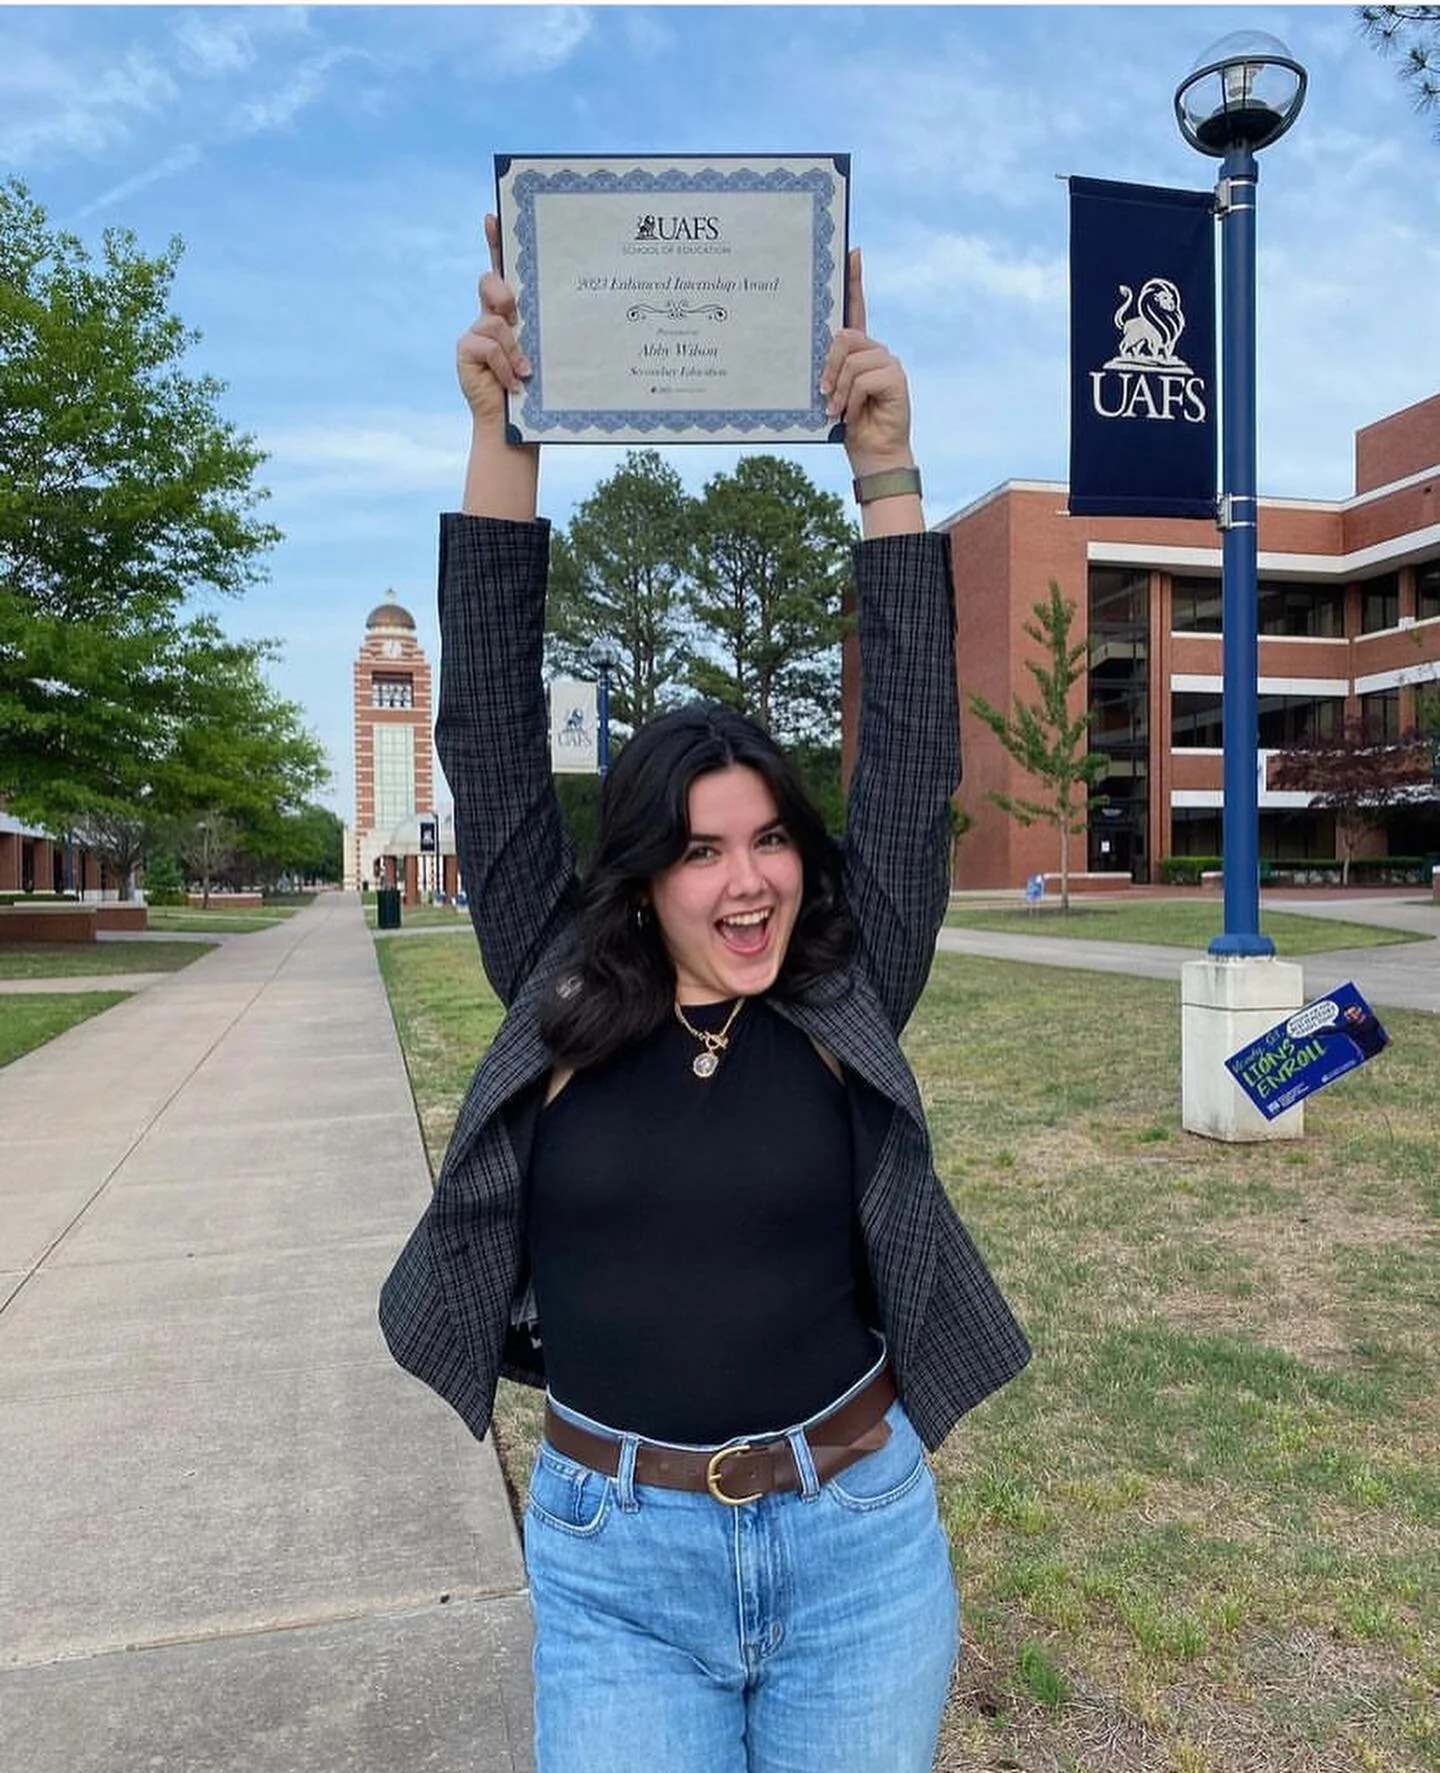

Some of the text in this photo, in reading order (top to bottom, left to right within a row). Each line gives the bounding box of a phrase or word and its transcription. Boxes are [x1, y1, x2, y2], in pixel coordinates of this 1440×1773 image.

[657, 217, 719, 240] UAFS
[622, 245, 731, 255] SCHOOL OF EDUCATION
[610, 275, 671, 291] Enhanced
[674, 276, 736, 293] Internship
[738, 276, 780, 291] Award
[676, 343, 719, 356] Wilson
[1089, 371, 1206, 423] UAFS
[1242, 1037, 1296, 1088] LIONS
[1256, 1040, 1328, 1099] ENROLL
